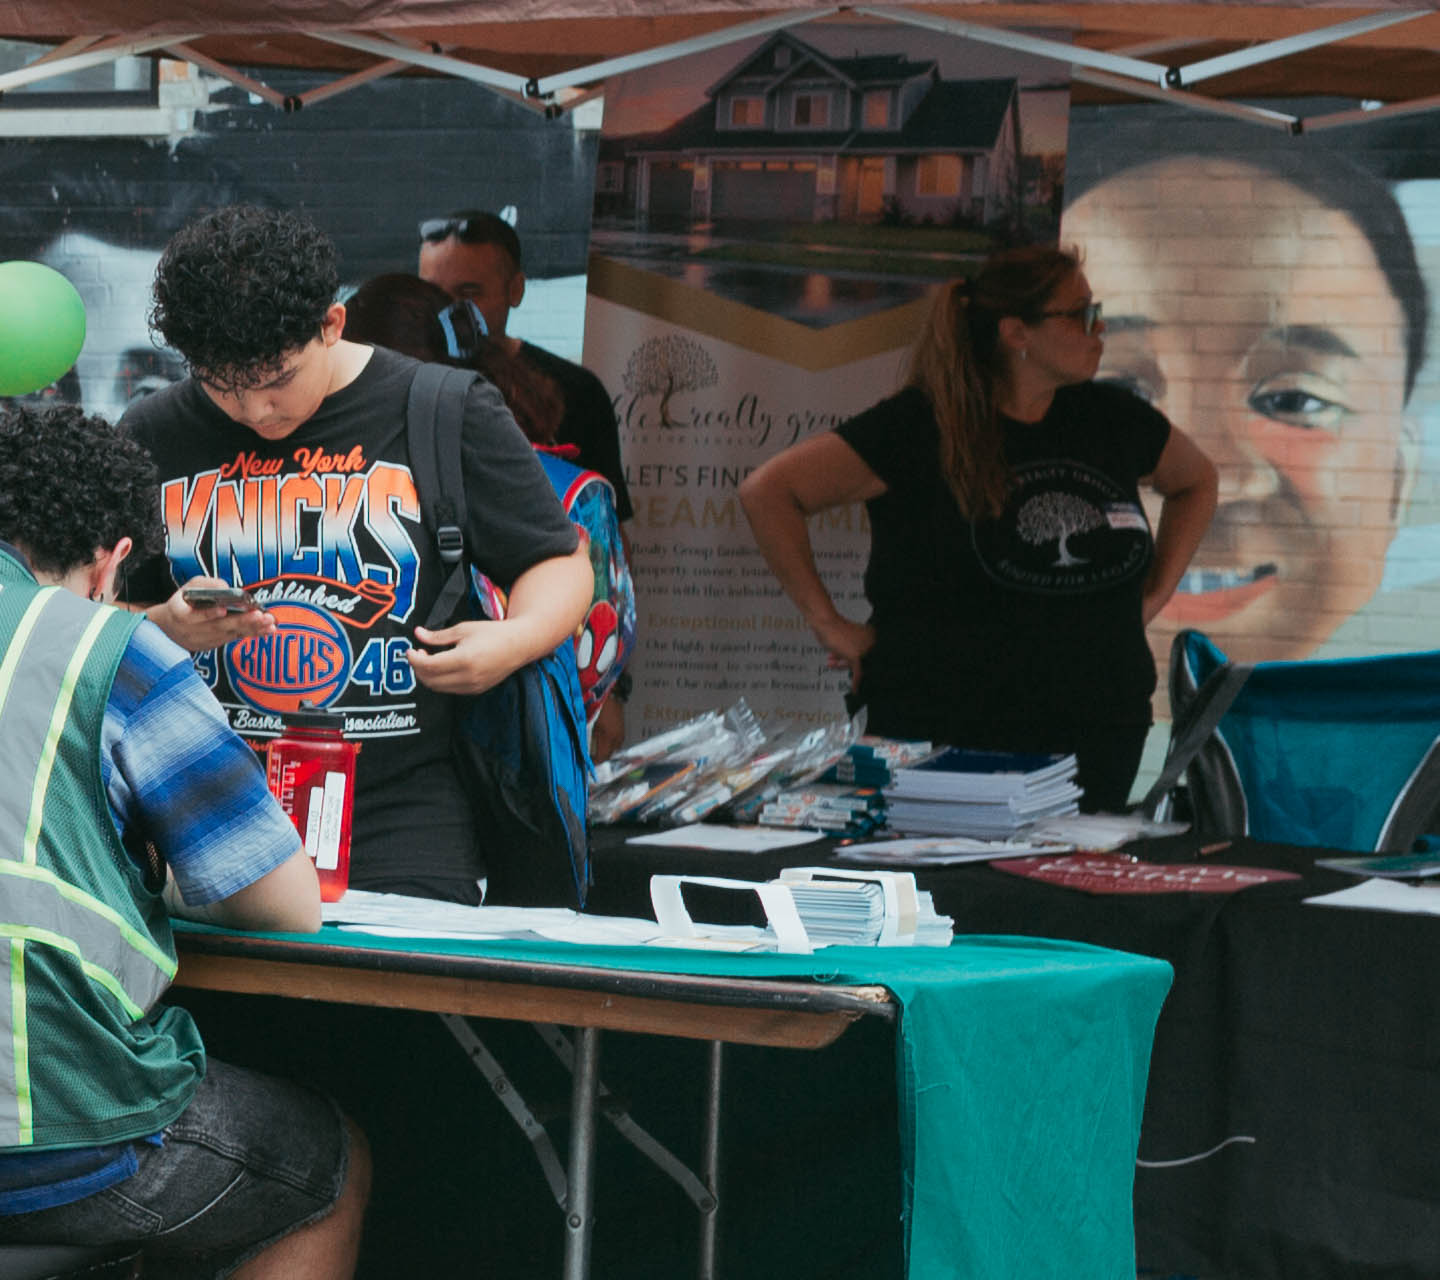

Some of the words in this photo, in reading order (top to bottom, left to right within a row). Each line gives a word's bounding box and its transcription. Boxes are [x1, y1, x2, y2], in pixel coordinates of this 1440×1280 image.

[219, 451, 284, 483] New
[293, 443, 368, 480] York
[625, 464, 689, 487] LET'S
[633, 495, 738, 529] REAM
[161, 460, 421, 624] KNICKS
[253, 581, 362, 614] ablished
[239, 634, 335, 686] KNICKS
[351, 636, 417, 696] 46
[343, 710, 417, 733] sociation
